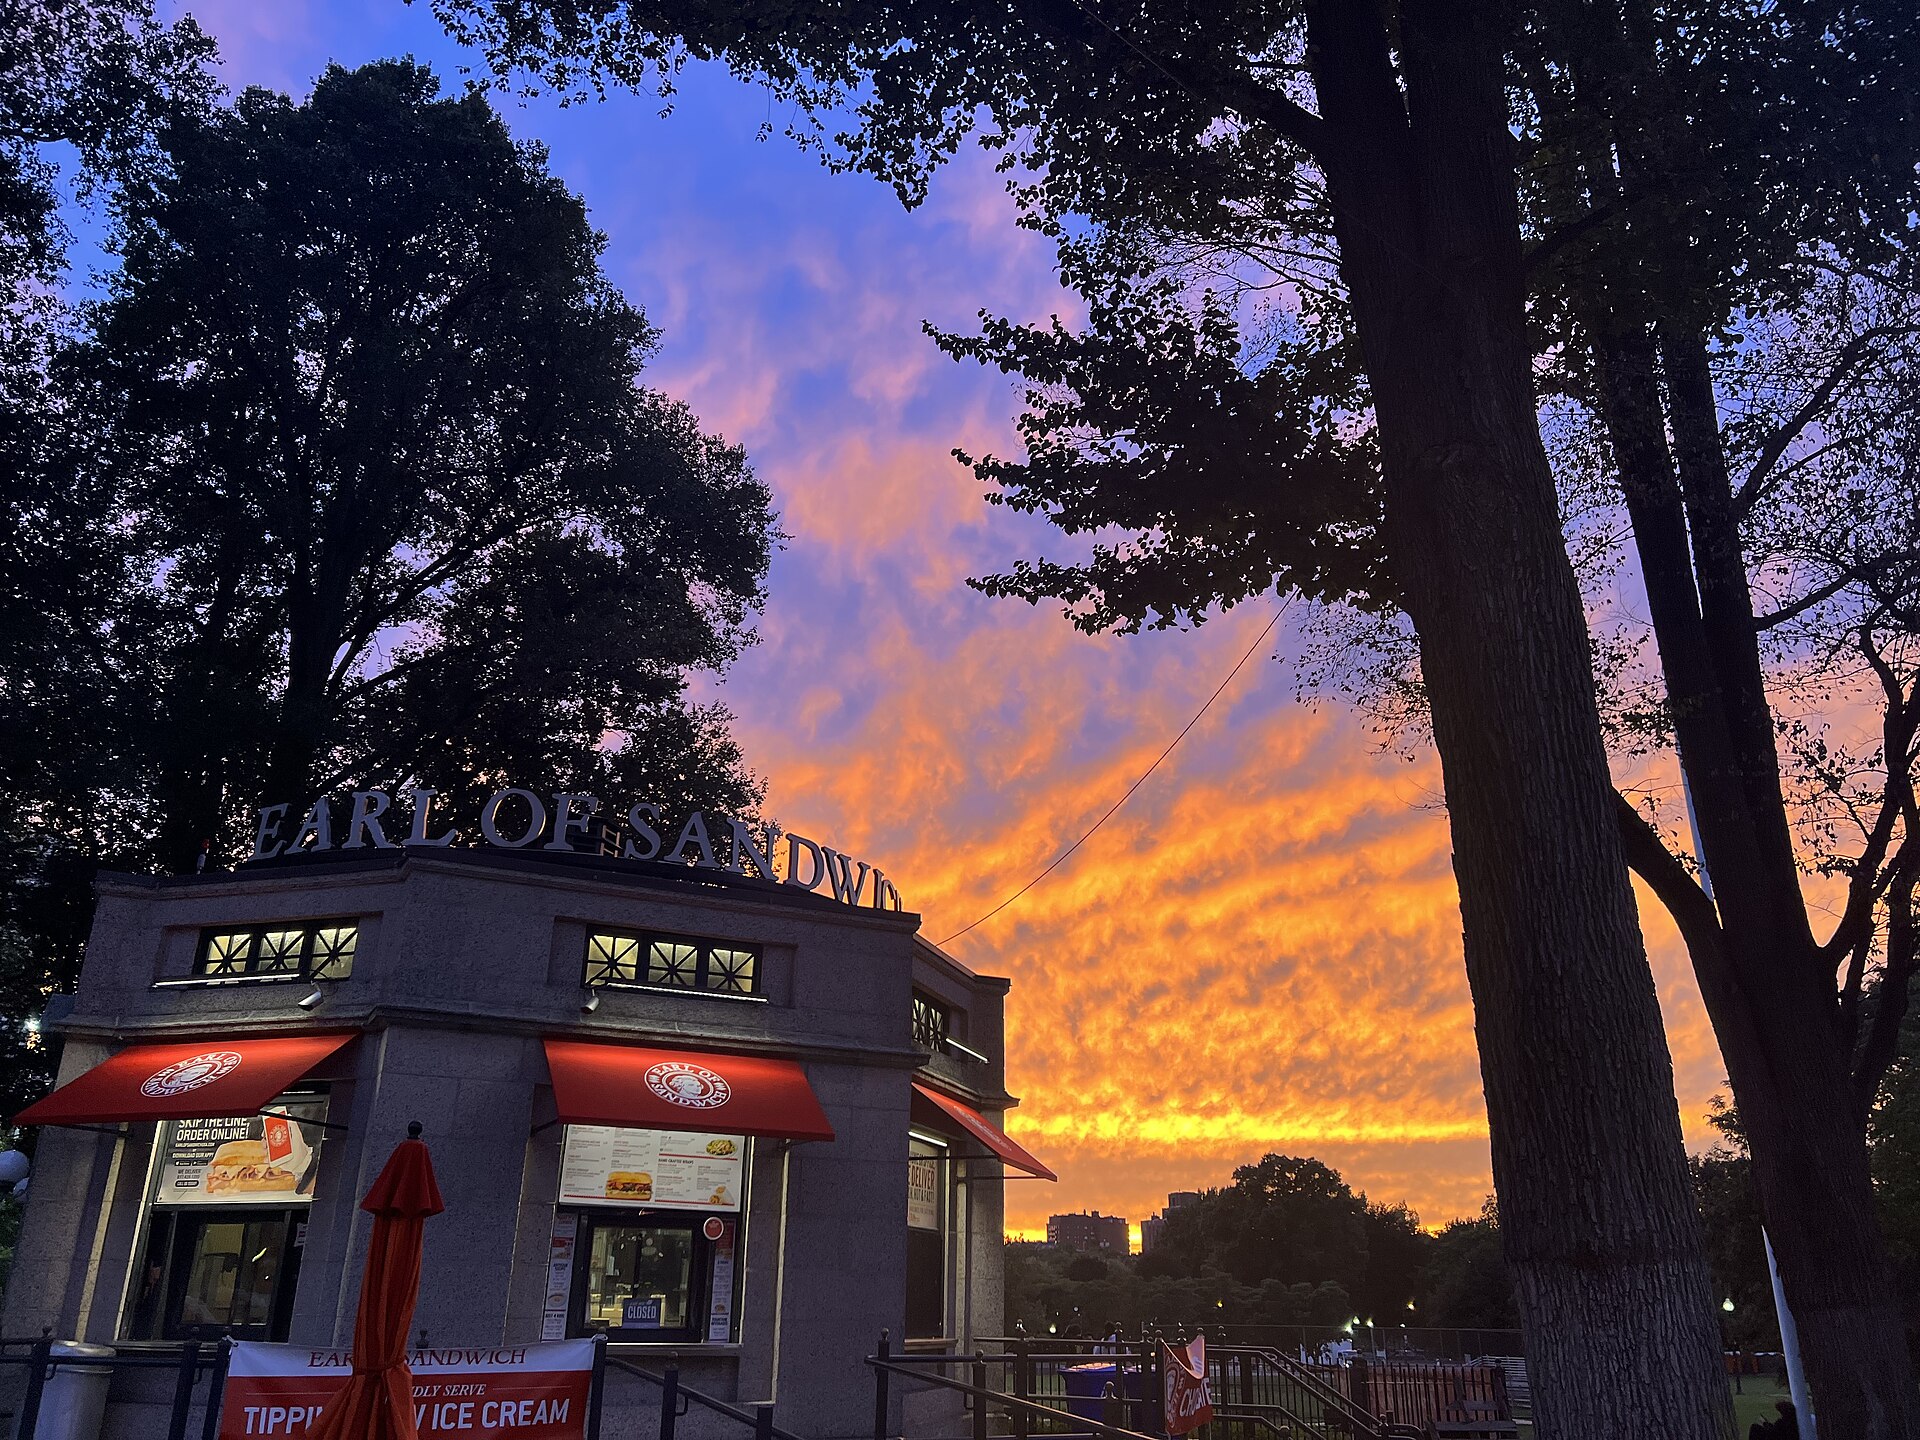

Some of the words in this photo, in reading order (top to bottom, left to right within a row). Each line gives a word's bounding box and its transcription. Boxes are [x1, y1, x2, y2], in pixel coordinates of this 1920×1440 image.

[249, 788, 459, 862] EARL
[480, 787, 600, 851] OF
[177, 1052, 227, 1069] EARL
[651, 1063, 695, 1077] EARL
[698, 1070, 721, 1083] OF
[650, 1083, 728, 1108] SANDWICH
[176, 1128, 210, 1141] ORDER
[211, 1127, 249, 1140] ONLINE!
[911, 1164, 935, 1191] DELIVER
[627, 1305, 657, 1319] CLOSED
[307, 1351, 354, 1368] EAR
[442, 1383, 487, 1397] SERVE
[243, 1406, 324, 1434] TIPPI
[431, 1402, 475, 1431] ICE
[481, 1398, 570, 1430] CREAM
